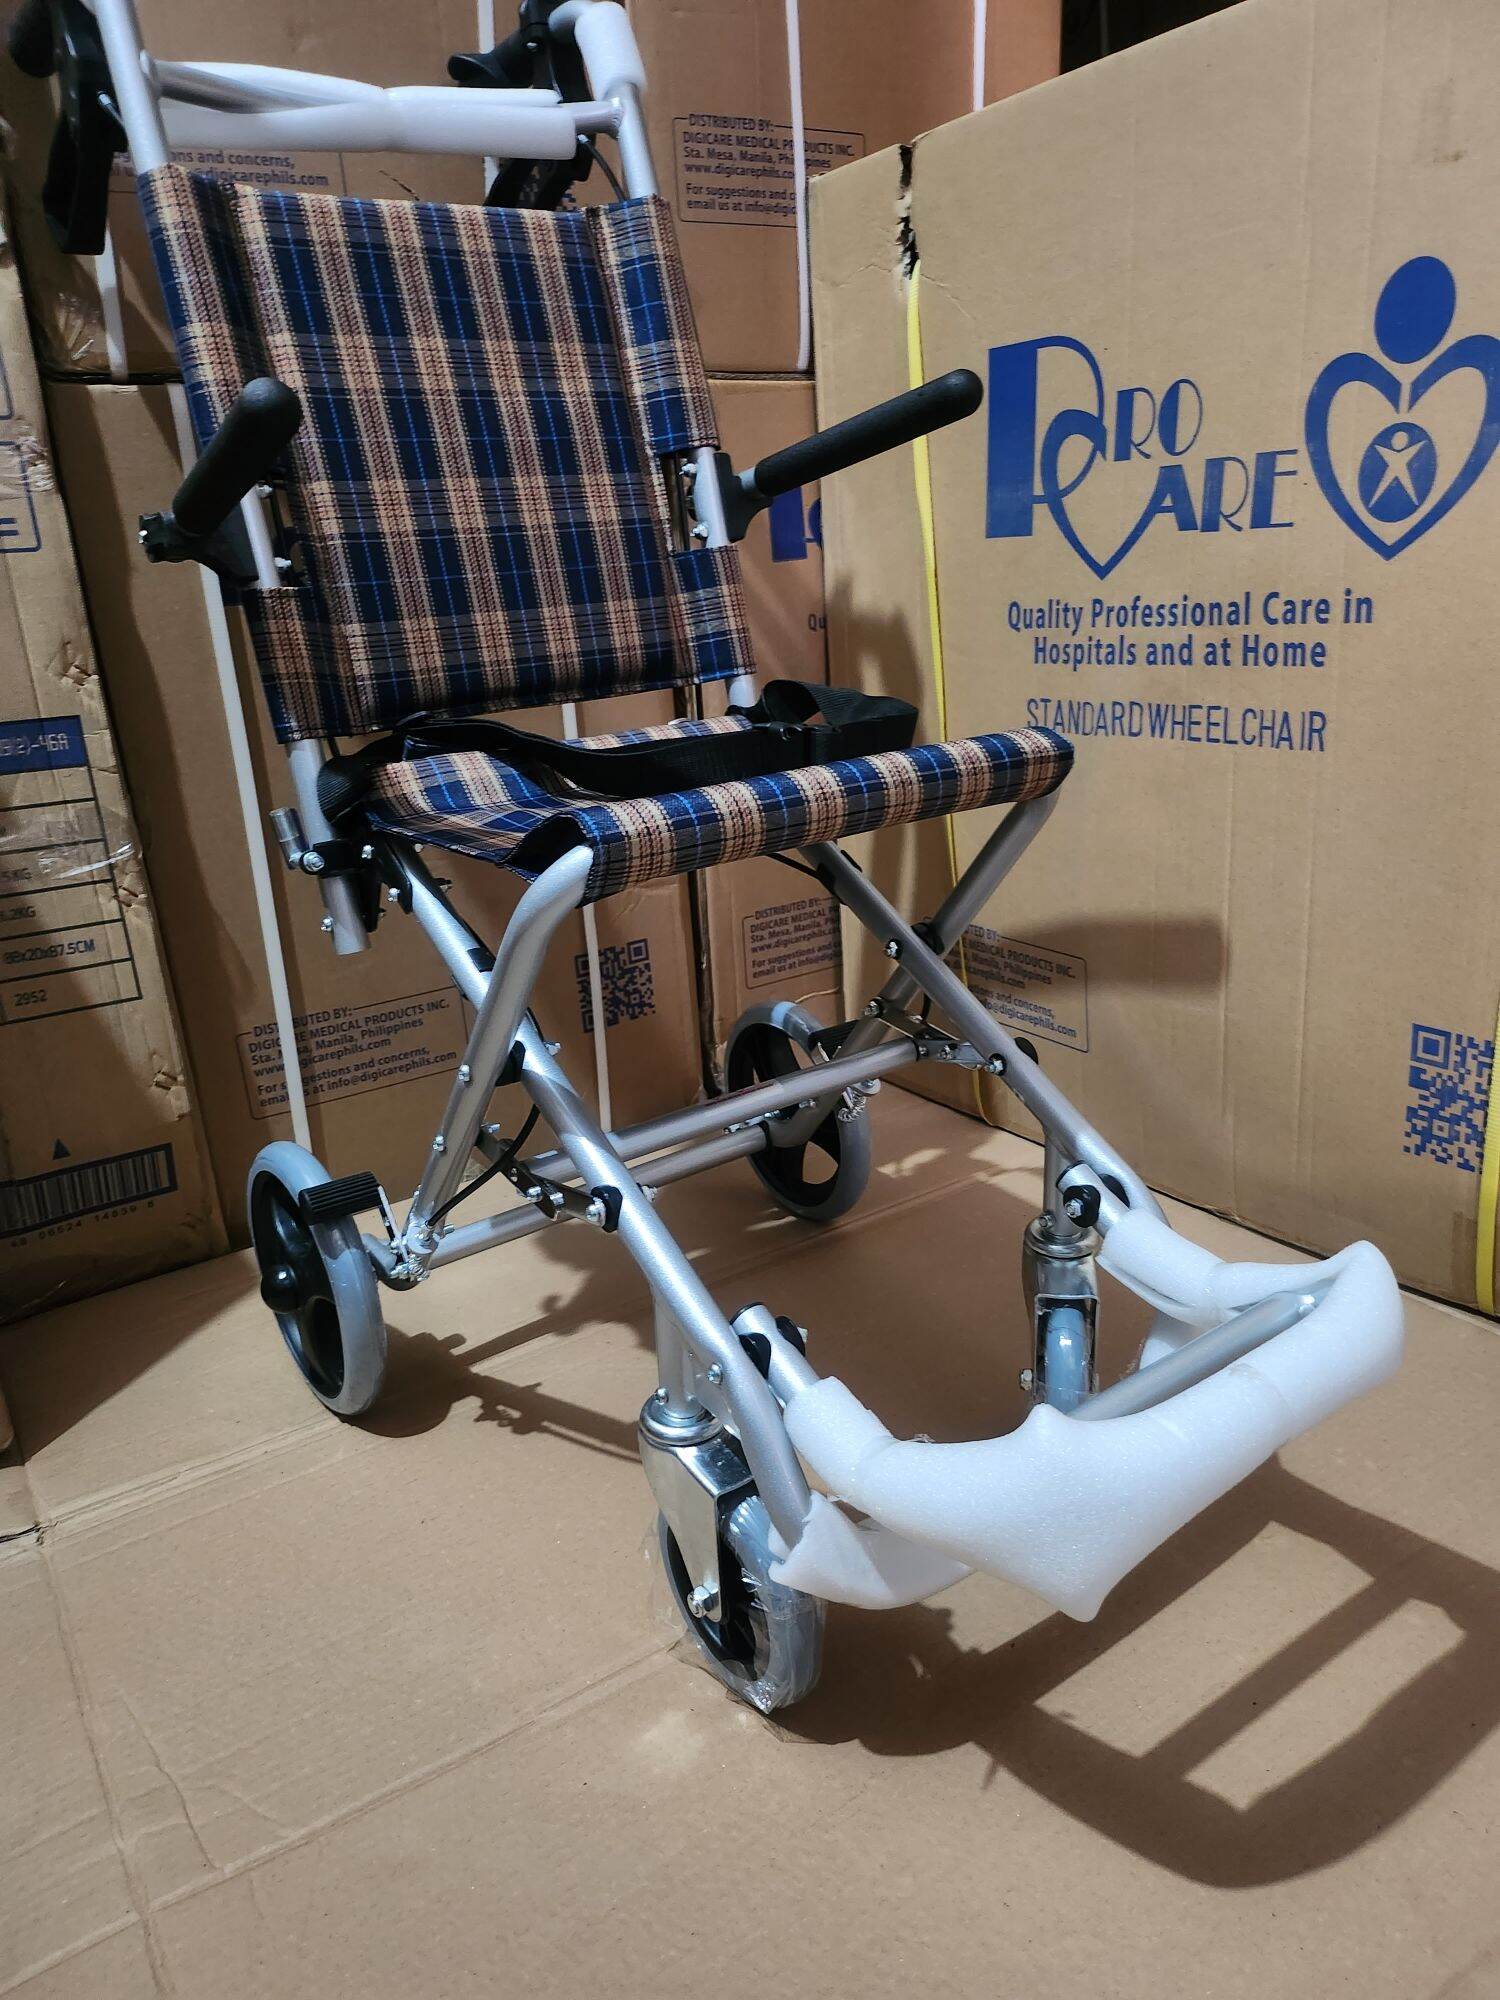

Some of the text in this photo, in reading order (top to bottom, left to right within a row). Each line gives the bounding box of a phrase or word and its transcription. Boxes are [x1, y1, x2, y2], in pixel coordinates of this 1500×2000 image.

[688, 113, 774, 132] DISTRIBUTED BY:
[683, 131, 732, 147] DIGICARE
[735, 136, 780, 150] MEDICAL
[197, 150, 225, 164] and
[228, 153, 296, 169] concerns,
[684, 147, 703, 159] Sta.
[686, 182, 703, 195] For
[705, 185, 767, 201] suggestions
[768, 187, 787, 200] and
[687, 199, 717, 210] email
[718, 201, 731, 211] us
[731, 200, 743, 212] at
[1008, 587, 1374, 636] Quality Professional Care in
[1033, 633, 1328, 672] Hospitals and at Home
[750, 919, 789, 934] DIGICARE
[791, 908, 827, 924] MEDICAL
[755, 900, 808, 920] DISTRIBUTED
[1007, 948, 1054, 973] PRODUCTS
[310, 1020, 362, 1041] MEDICAL
[364, 1005, 425, 1028] PRODUCTS
[426, 998, 450, 1013] INC.
[333, 1006, 353, 1019] BY:
[252, 1052, 276, 1066] Sta.
[315, 1032, 358, 1051] Manila,
[360, 1016, 424, 1041] Philippines
[257, 1083, 278, 1096] For
[353, 1059, 376, 1072] and
[377, 1045, 430, 1067] concerns,
[312, 1082, 326, 1096] at
[327, 1050, 458, 1092] info@digicarephils.com
